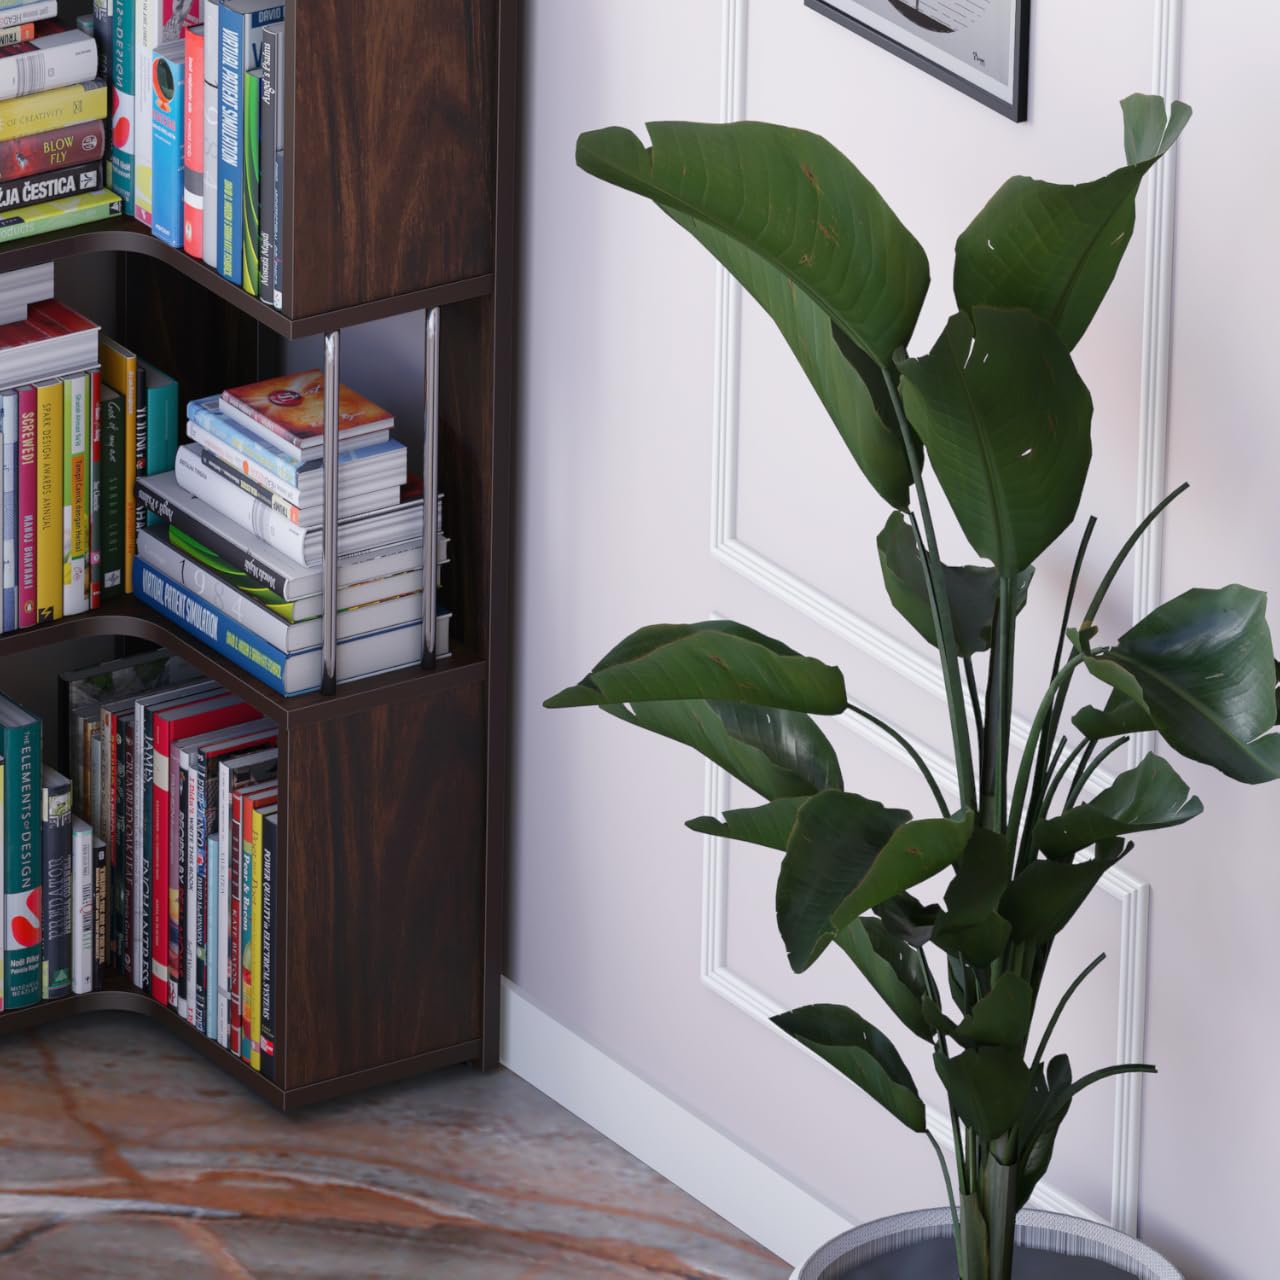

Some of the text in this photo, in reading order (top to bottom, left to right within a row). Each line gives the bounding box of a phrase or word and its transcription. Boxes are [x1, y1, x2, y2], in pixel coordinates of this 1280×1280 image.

[258, 8, 282, 23] DAVID
[262, 42, 272, 71] Psalms
[19, 108, 63, 125] CREATIVITY
[222, 28, 239, 167] VIRTUAL PATIENT SIMULATION
[43, 135, 74, 154] BLOW
[49, 151, 68, 165] FLY
[22, 176, 76, 203] ČESTICA
[41, 403, 52, 531] SPARK DESIGN AWARDS ANNUAL
[23, 515, 33, 543] MANOJ
[272, 503, 288, 519] TRUMP
[142, 568, 165, 606] VIRTUAL
[164, 583, 187, 619] PATIENT
[23, 732, 31, 745] THE
[145, 735, 153, 782] JAMES
[21, 746, 32, 820] ELEMENTS
[21, 831, 32, 889] DESIGN
[263, 848, 271, 881] POWER
[48, 857, 64, 941] PREDATOR
[243, 854, 251, 931] Pear & Bacon
[262, 881, 271, 922] QUALITY
[263, 929, 271, 981] ELECTRICAL
[262, 982, 270, 1020] SYSTEMS
